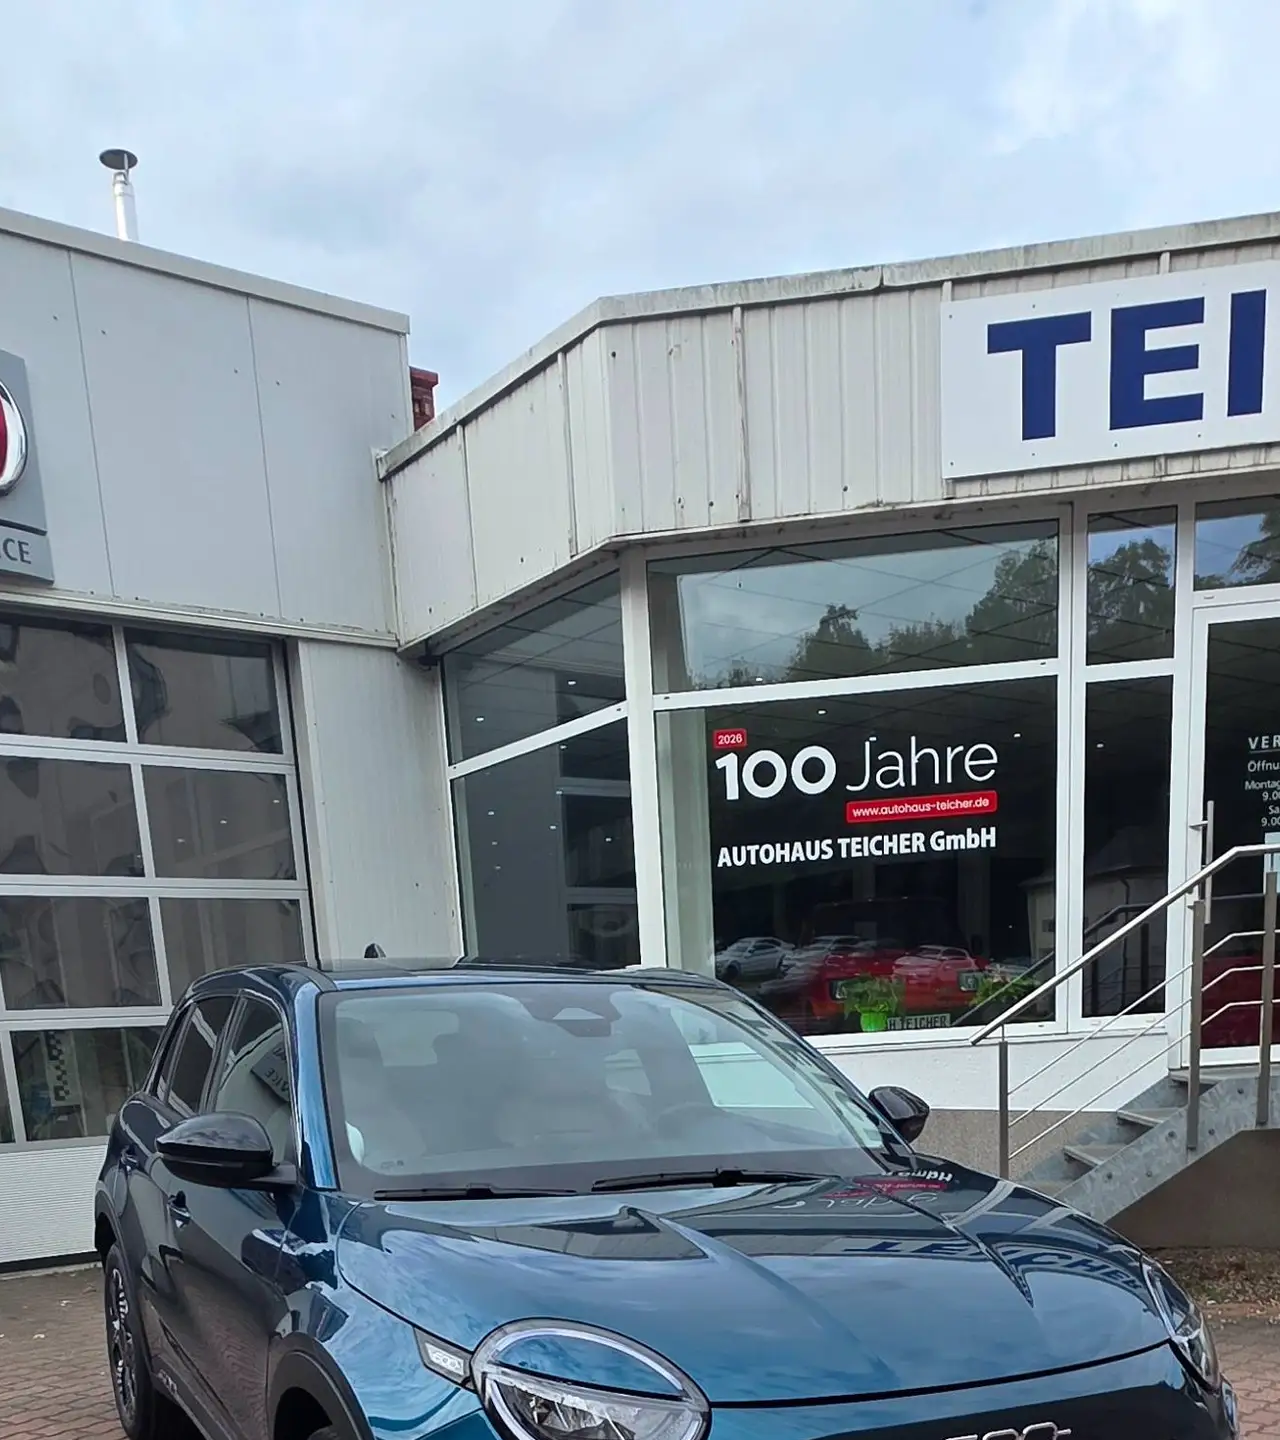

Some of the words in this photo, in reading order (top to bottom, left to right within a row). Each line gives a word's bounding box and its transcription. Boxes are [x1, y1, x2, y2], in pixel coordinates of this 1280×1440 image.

[718, 733, 743, 746] 2026
[715, 745, 837, 800] 100
[845, 735, 998, 792] Jahre
[852, 797, 990, 818] www.autohaus-teicher.de
[717, 838, 834, 868] AUTOHAUS
[837, 831, 926, 859] TEICHER
[930, 826, 996, 851] GmbH
